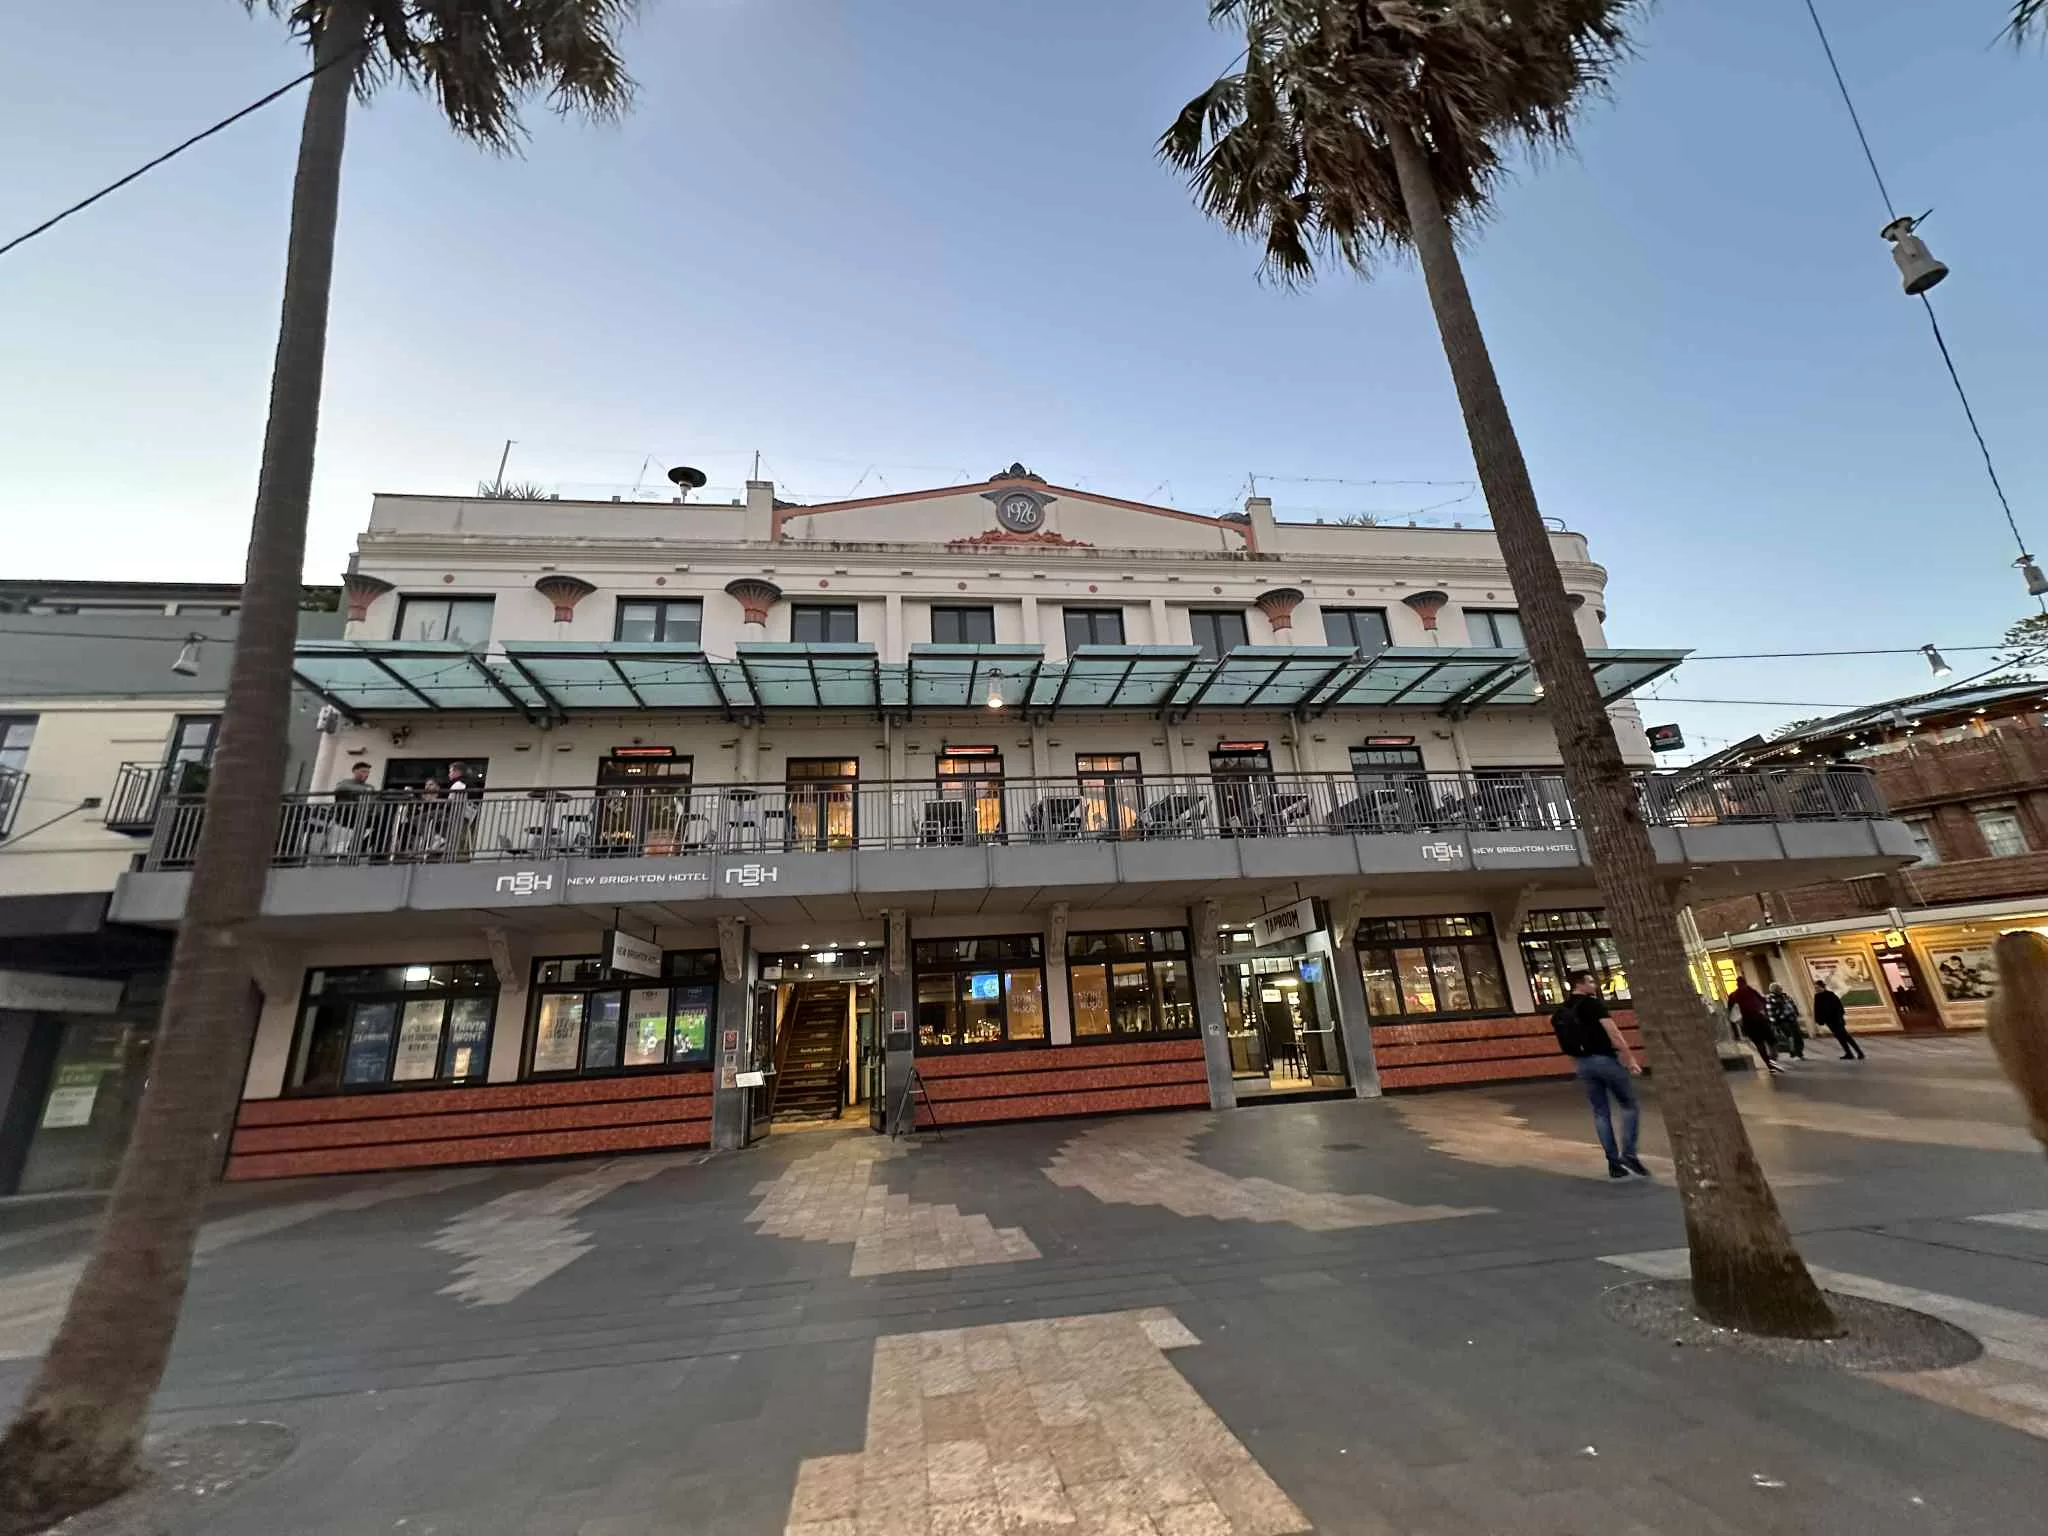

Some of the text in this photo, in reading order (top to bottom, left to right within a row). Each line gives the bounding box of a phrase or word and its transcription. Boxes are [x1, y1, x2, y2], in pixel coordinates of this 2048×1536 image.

[1007, 501, 1036, 524] 1926
[1546, 844, 1576, 852] HOTEL
[567, 872, 709, 886] NEW BRIGHTON HOTEL
[1265, 909, 1300, 937] TAPROOM
